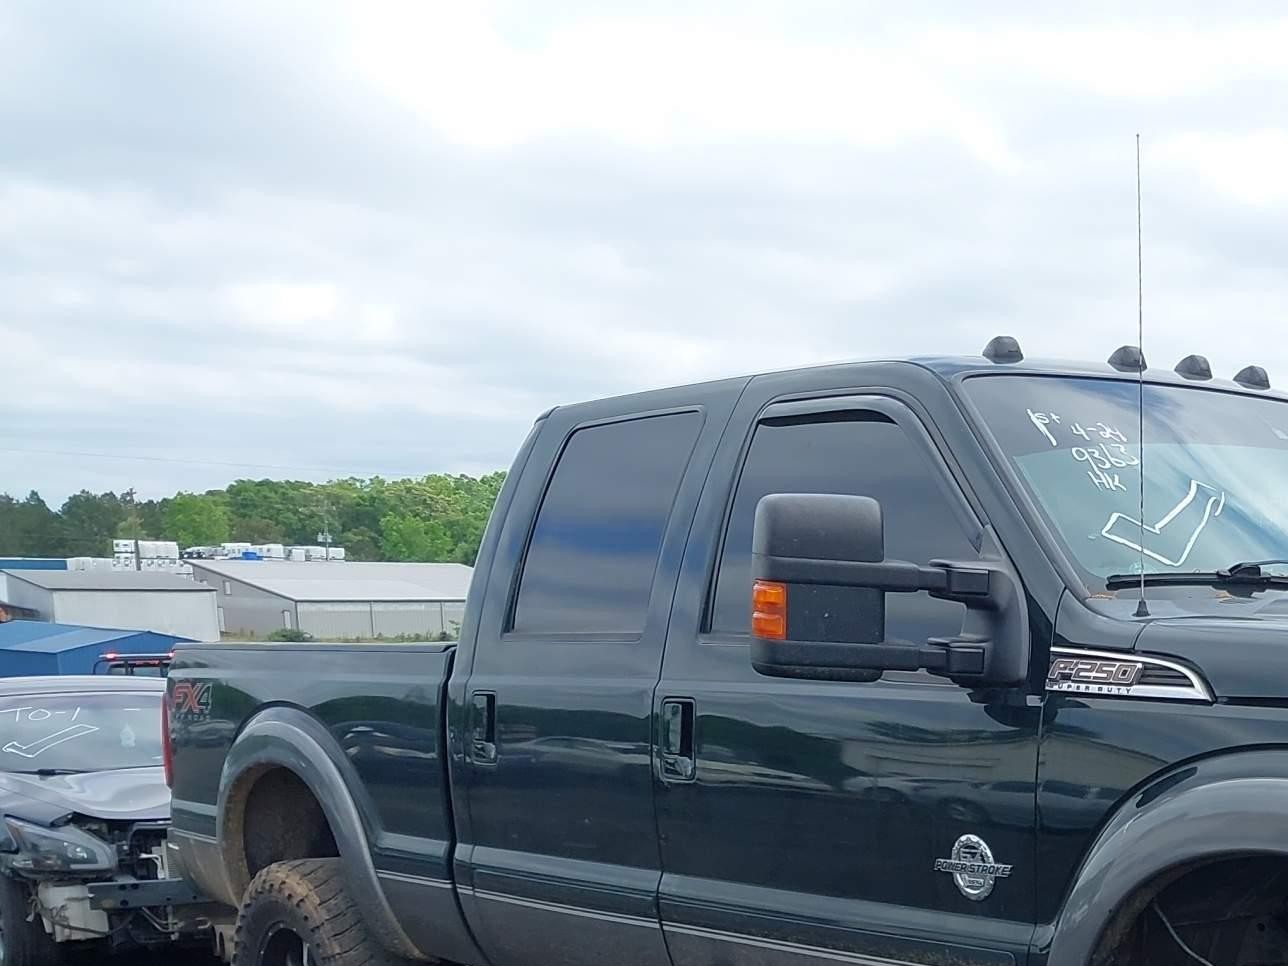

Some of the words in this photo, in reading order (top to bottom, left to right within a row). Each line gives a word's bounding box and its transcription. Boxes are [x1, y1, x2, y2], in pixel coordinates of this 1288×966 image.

[173, 682, 213, 713] FX4
[1097, 685, 1134, 695] DUTY
[935, 859, 967, 873] POWER
[968, 862, 1012, 877] STROKE
